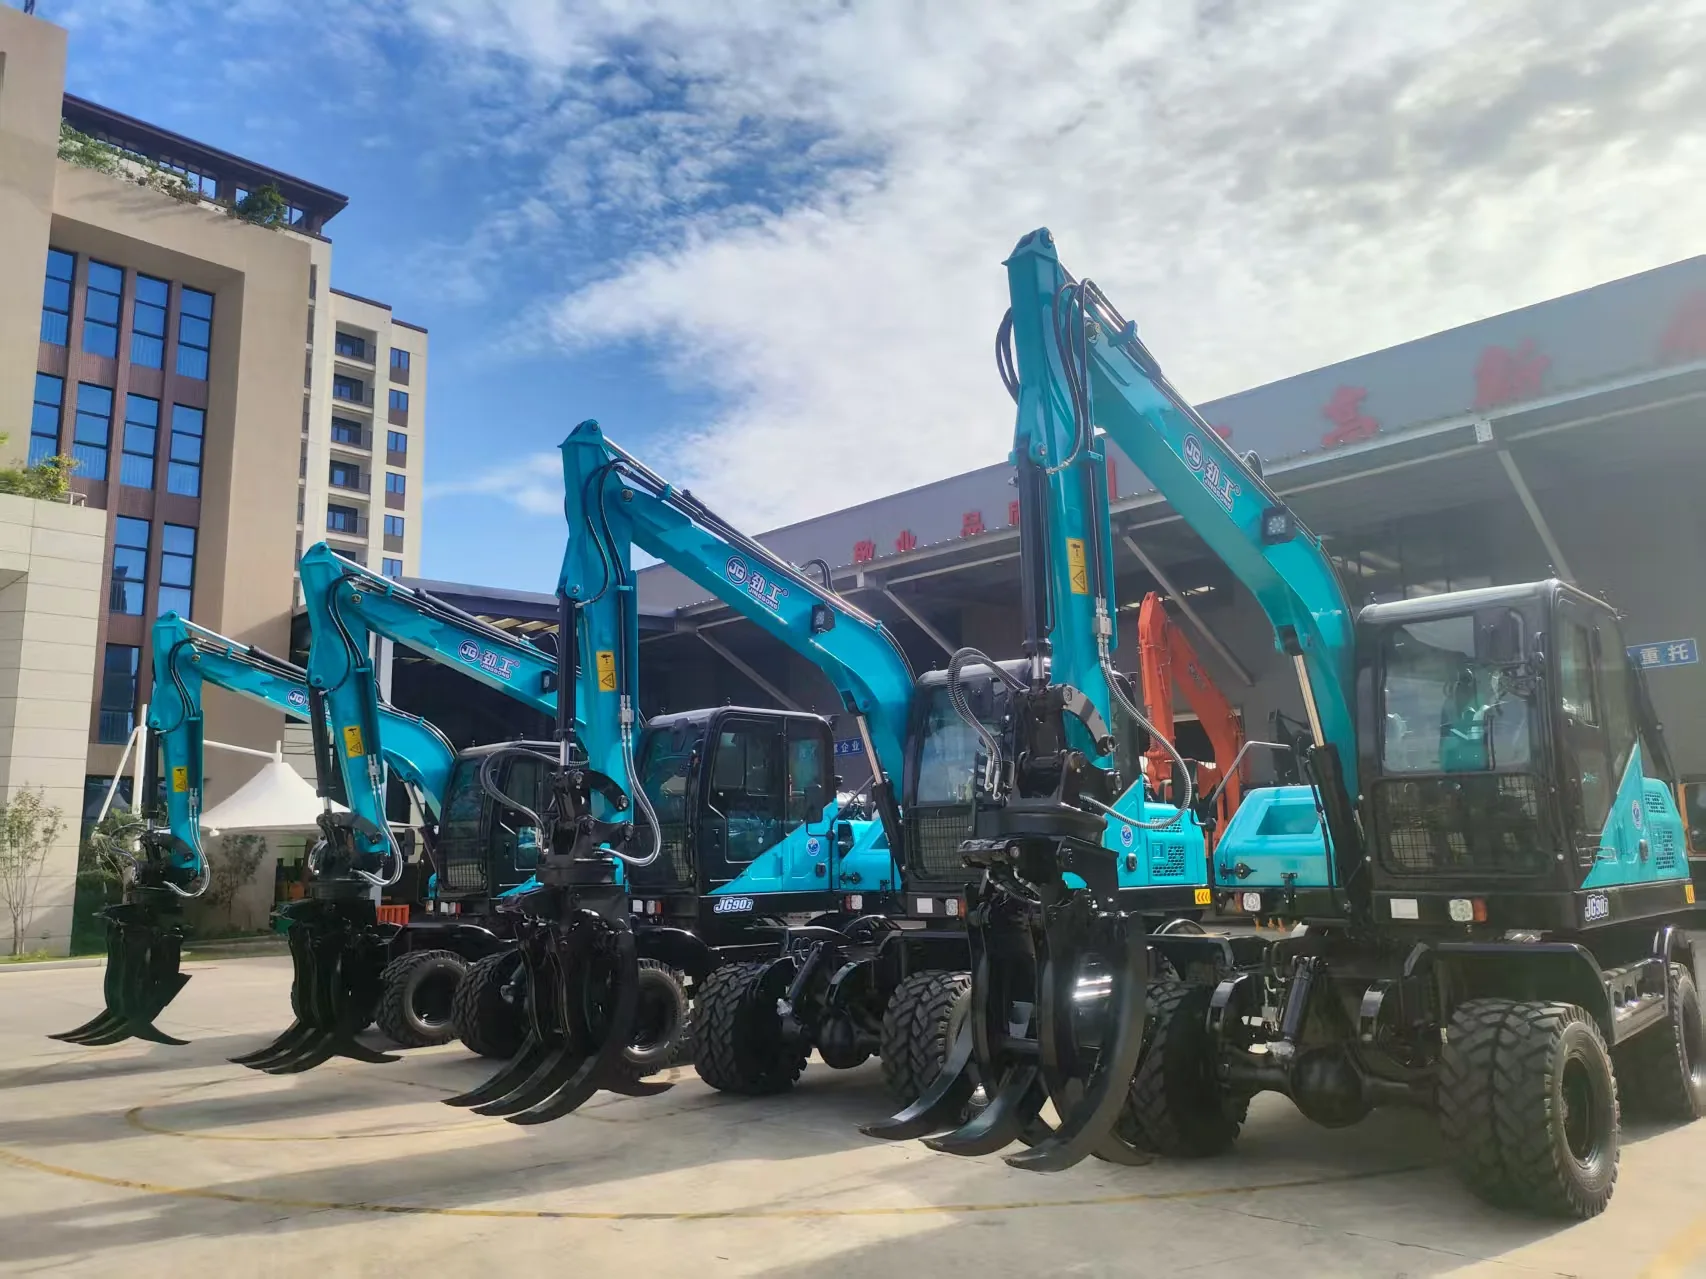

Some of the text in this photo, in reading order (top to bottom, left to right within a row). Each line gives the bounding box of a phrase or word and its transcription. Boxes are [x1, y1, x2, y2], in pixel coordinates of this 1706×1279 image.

[1186, 438, 1201, 466] JG
[1206, 457, 1233, 502] 劲工
[727, 559, 746, 581] JG
[750, 572, 782, 604] 劲工
[461, 643, 477, 659] JG
[482, 650, 512, 674] 劲工
[1640, 643, 1688, 665] 重托
[289, 691, 304, 704] JG
